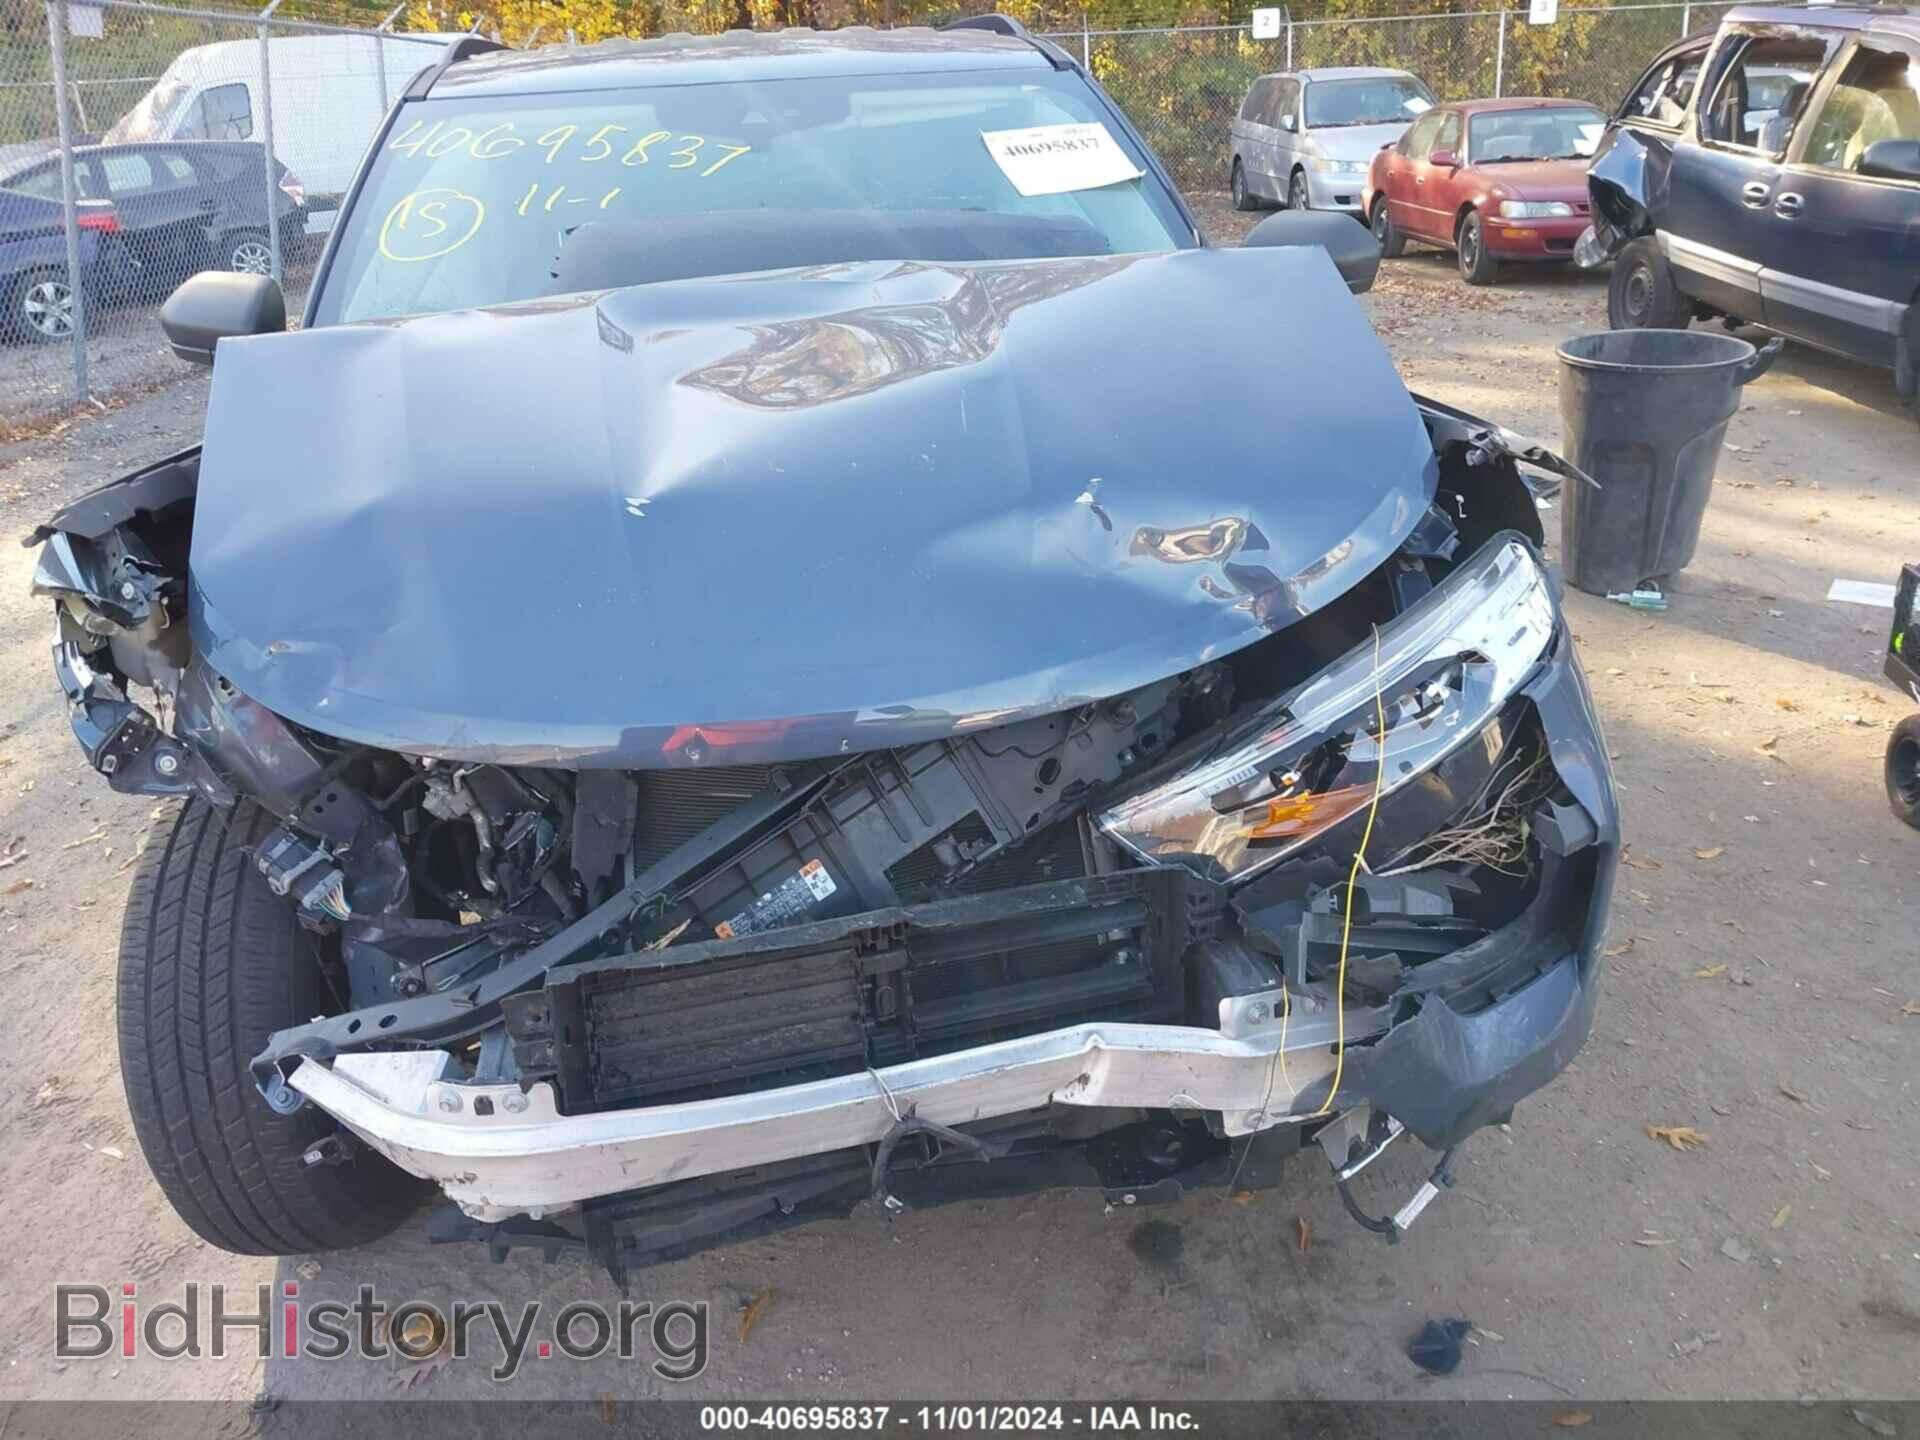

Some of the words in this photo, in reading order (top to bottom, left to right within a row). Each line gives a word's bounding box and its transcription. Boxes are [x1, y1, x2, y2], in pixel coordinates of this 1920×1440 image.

[1538, 1, 1549, 12] 3
[1262, 15, 1271, 27] 2
[388, 119, 752, 178] 40695837
[1004, 137, 1099, 157] 40695837
[516, 183, 622, 217] 11-1
